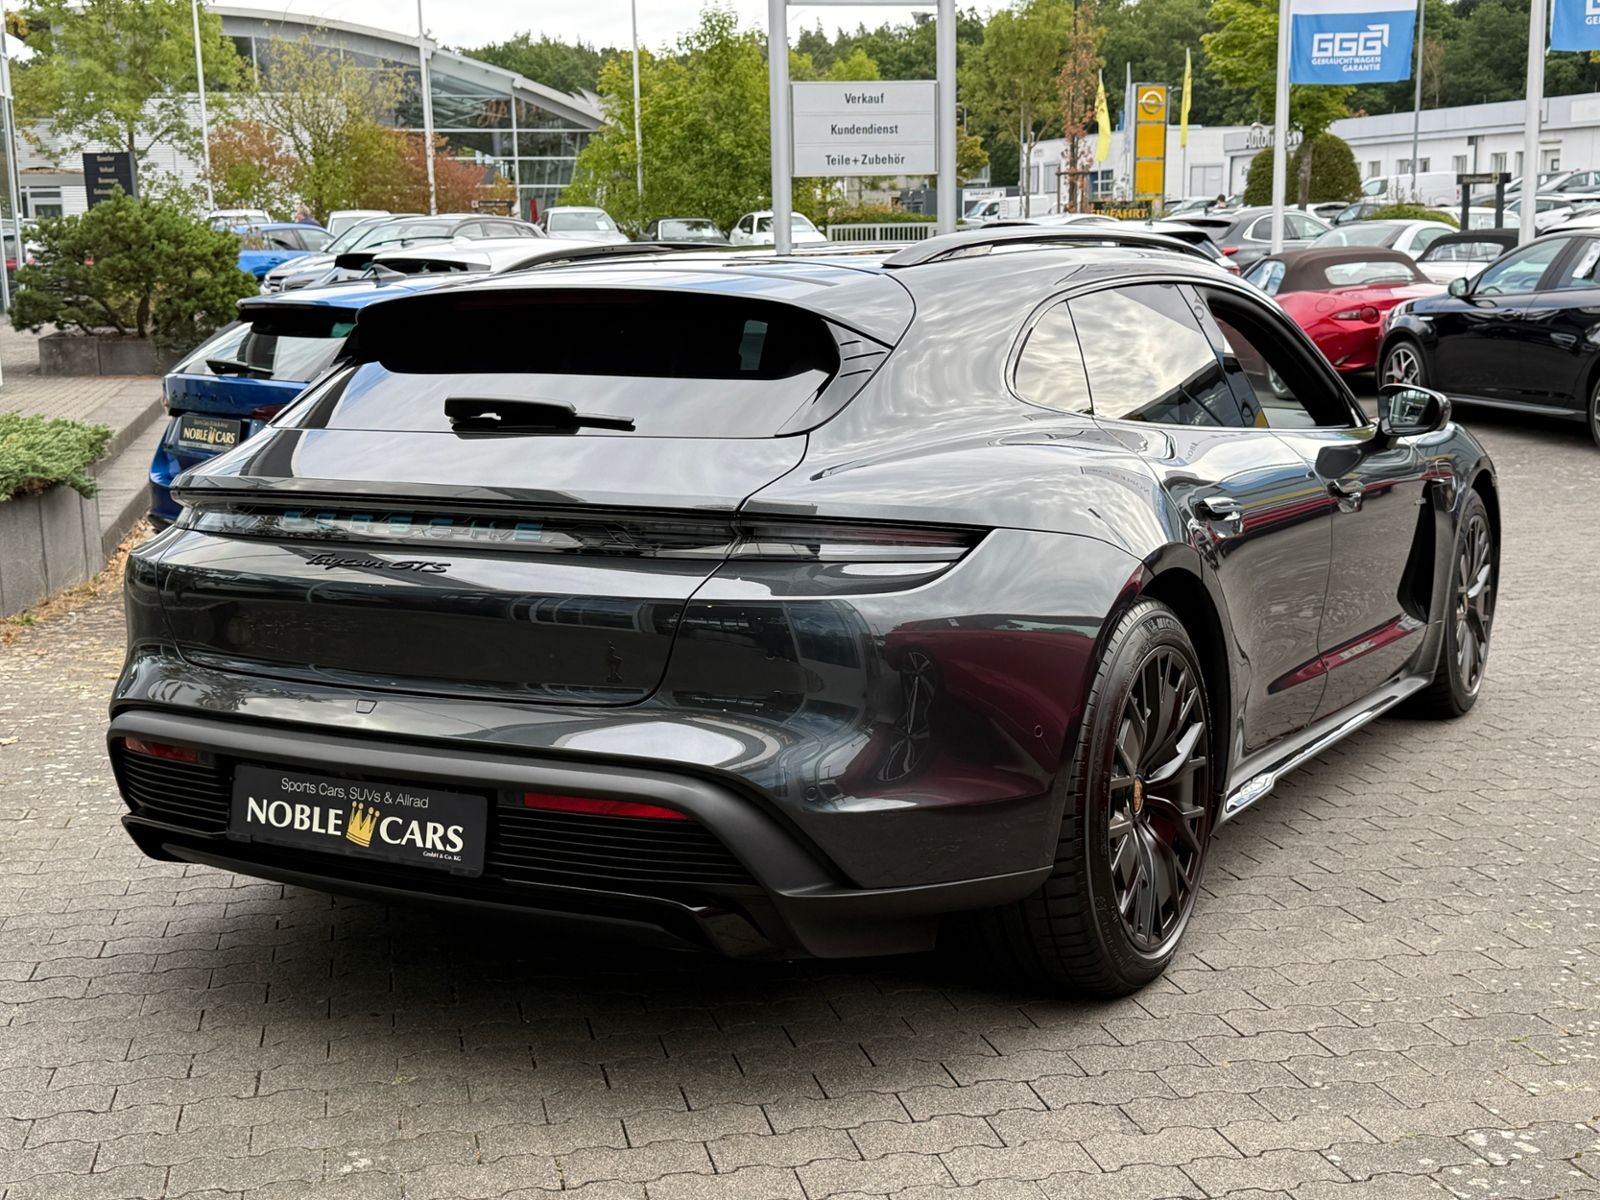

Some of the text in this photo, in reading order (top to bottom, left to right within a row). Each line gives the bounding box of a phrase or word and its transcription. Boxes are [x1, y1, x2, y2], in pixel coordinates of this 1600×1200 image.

[1311, 31, 1382, 57] GGG
[1311, 57, 1381, 66] GEBRAUCHTWAGEN
[1342, 63, 1381, 72] GARANTIE
[844, 92, 884, 104] Verkauf
[830, 123, 899, 135] Kundendienst
[183, 427, 236, 445] NOBLE CARS
[304, 552, 452, 574] Taycan GTS
[281, 777, 429, 809] Sports Cars, SUVs & Allrad
[246, 796, 464, 853] NOBLE CARS
[422, 850, 439, 859] GmbH
